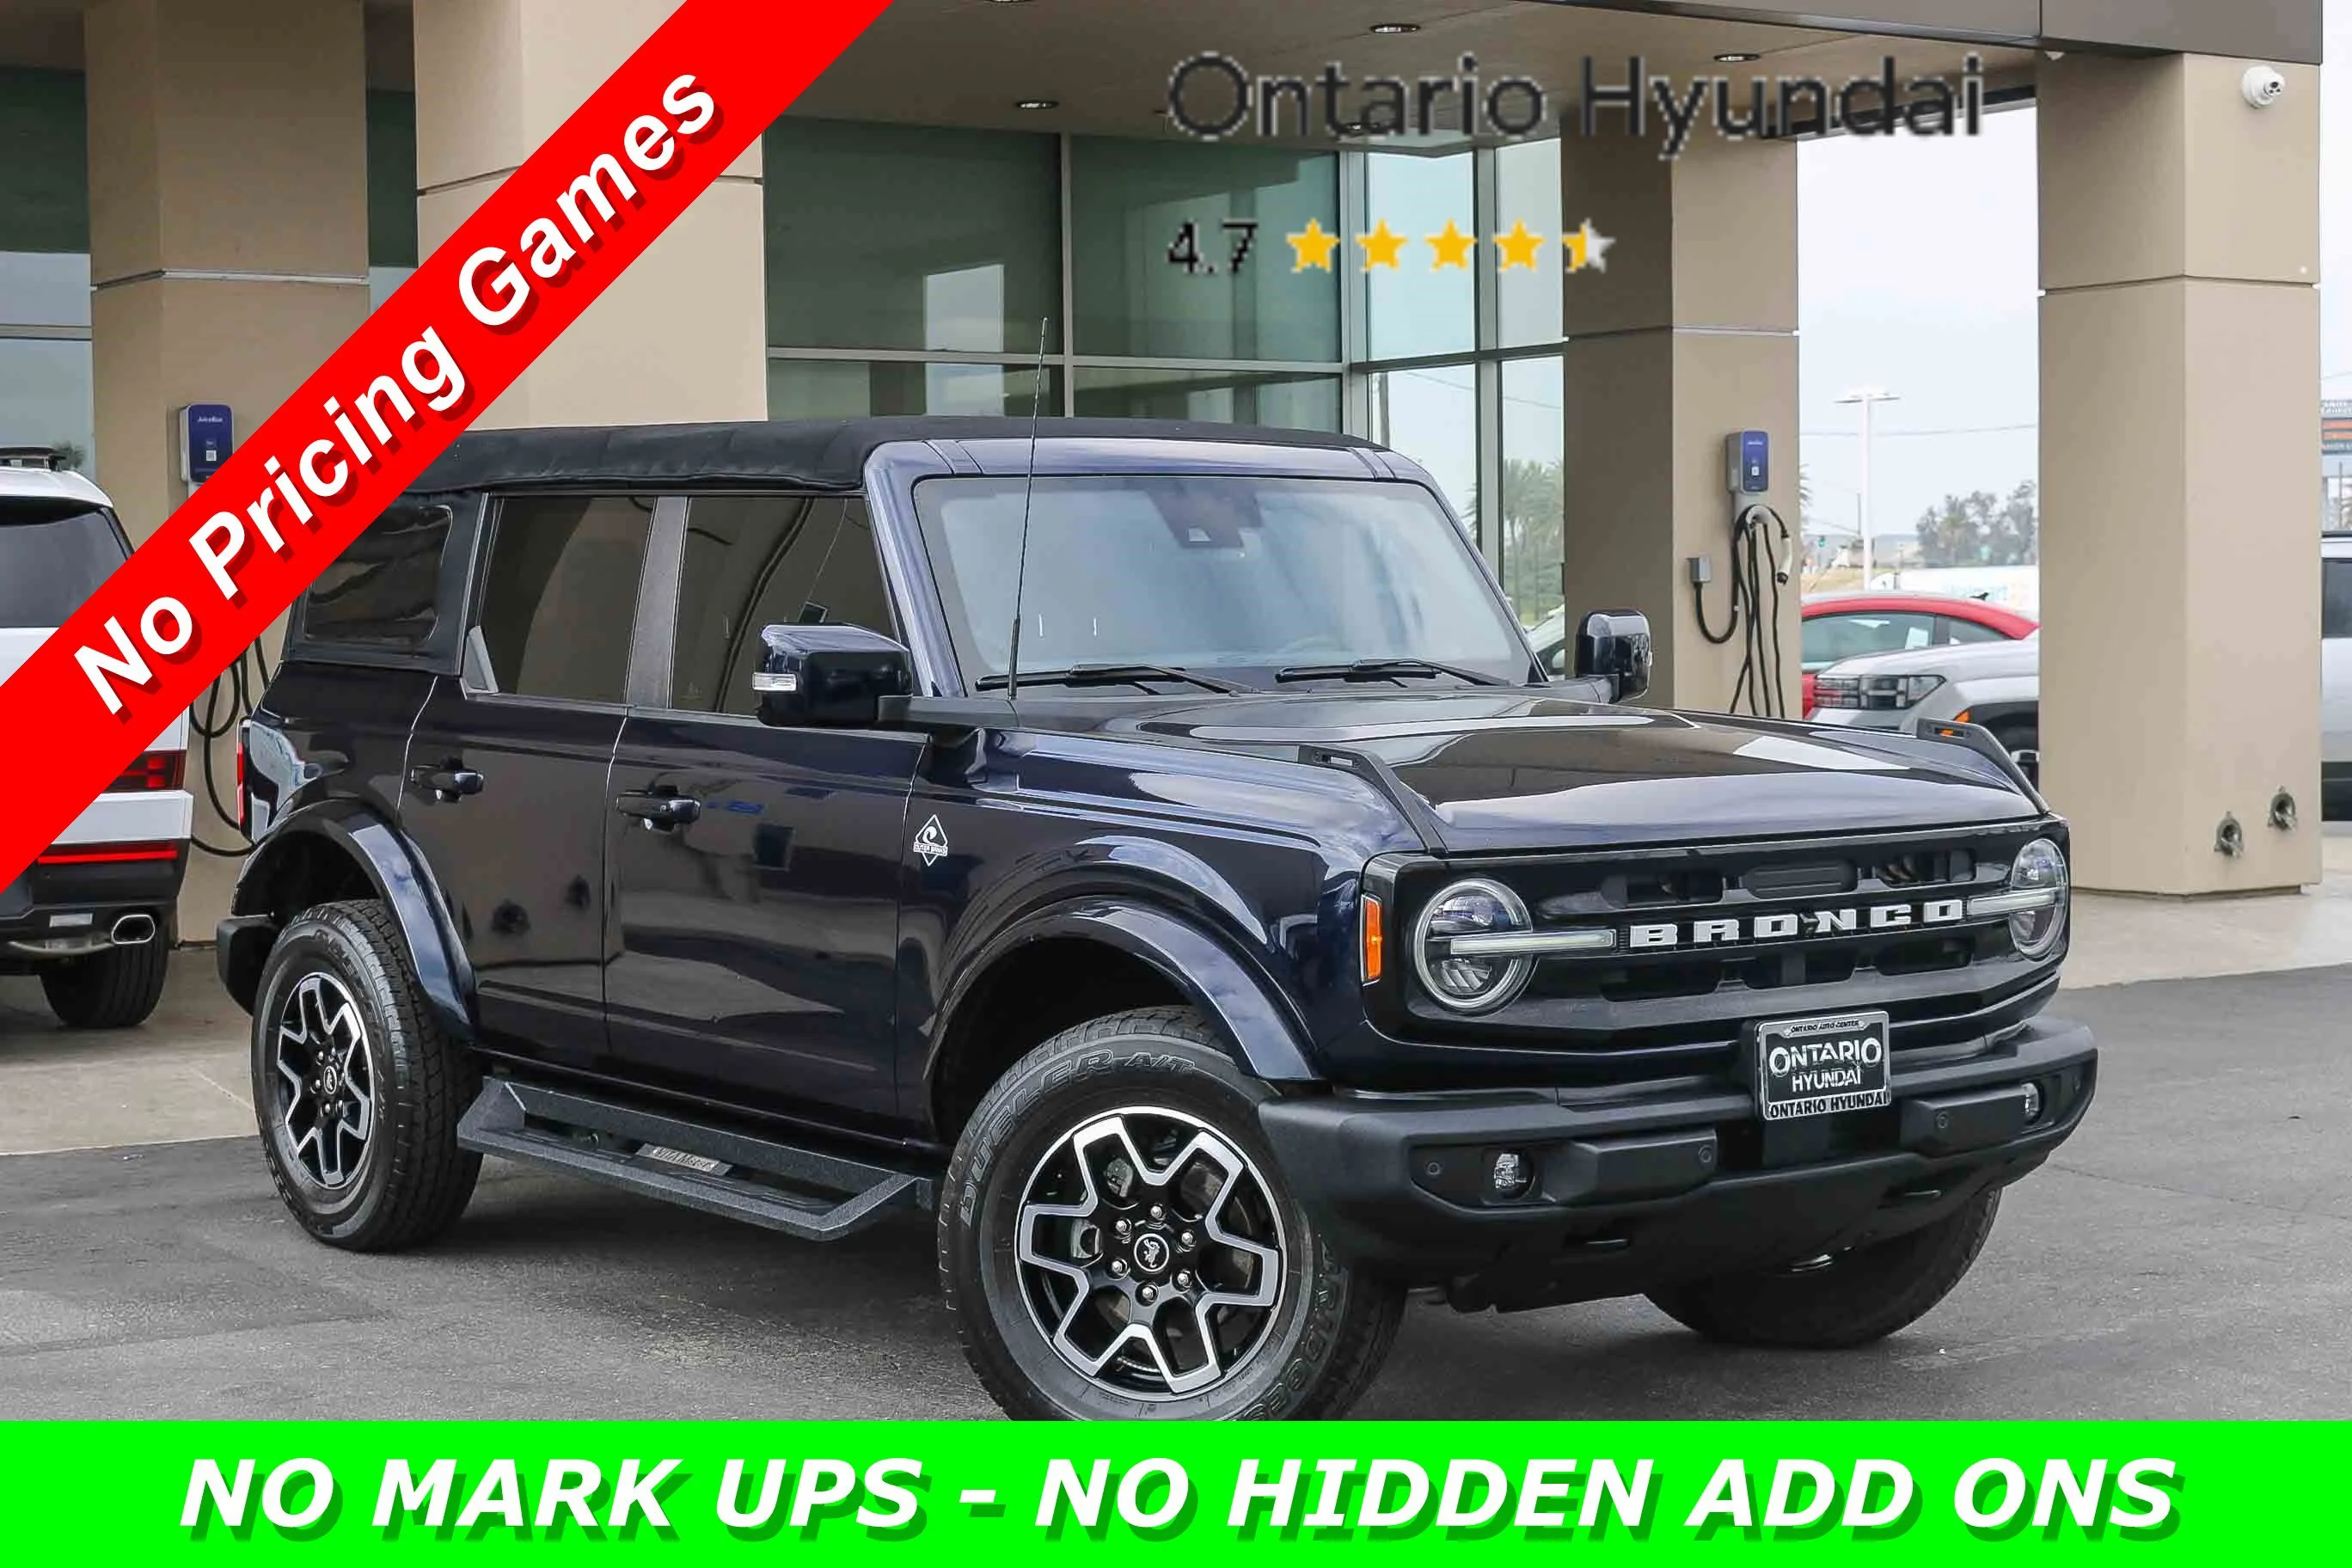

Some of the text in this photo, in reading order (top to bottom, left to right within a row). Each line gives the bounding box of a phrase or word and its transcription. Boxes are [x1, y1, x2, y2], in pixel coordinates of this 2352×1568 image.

[1630, 899, 1963, 947] BRONCO
[1791, 1023, 1817, 1032] ONTARIO
[1769, 1038, 1882, 1076] ONTARIO
[1792, 1068, 1862, 1093] HYUNDAI
[1770, 1091, 1888, 1118] ONTARIO HYUNDAI
[960, 1049, 1114, 1228] DUELER
